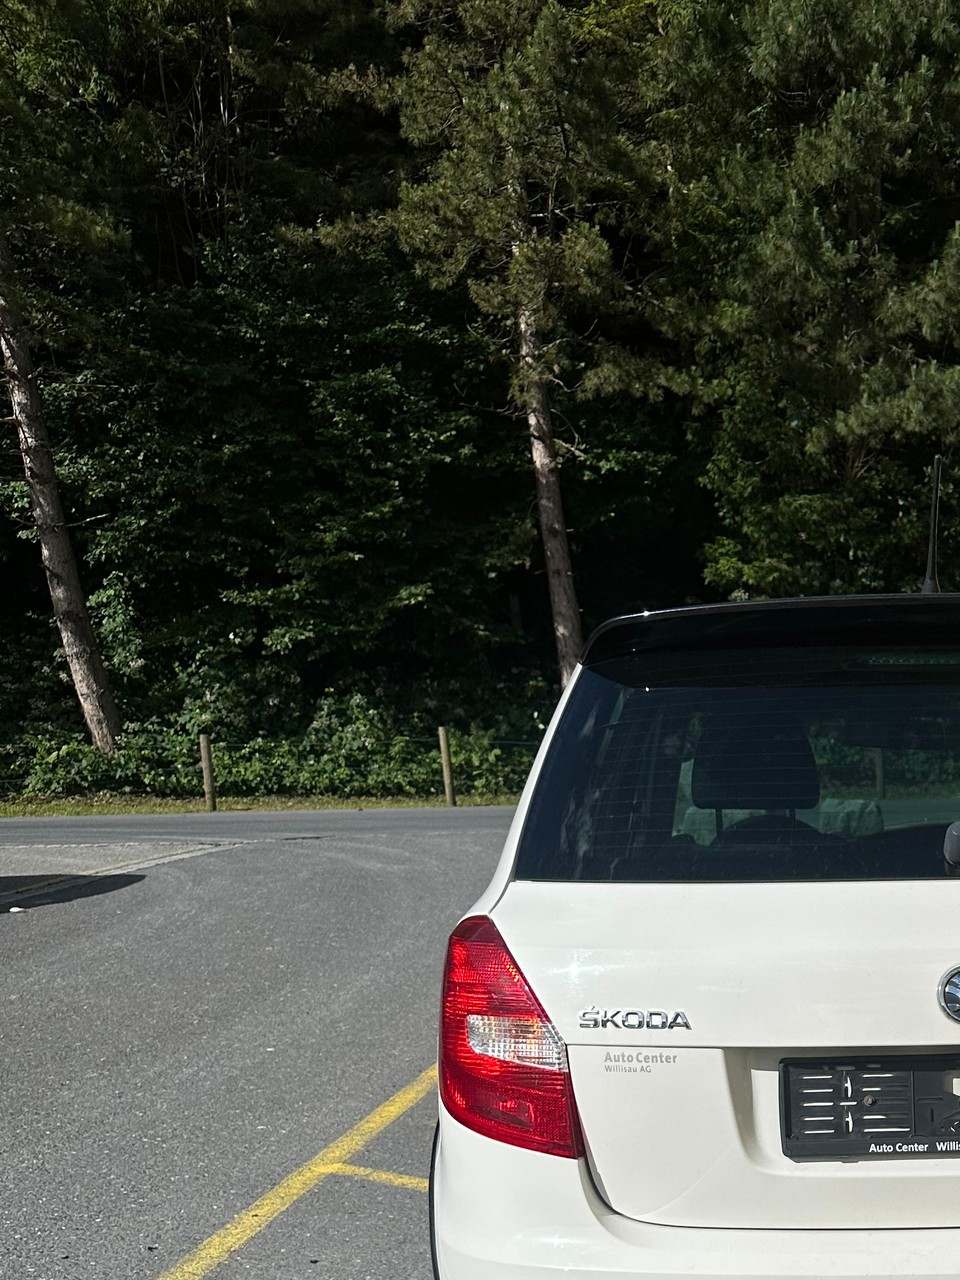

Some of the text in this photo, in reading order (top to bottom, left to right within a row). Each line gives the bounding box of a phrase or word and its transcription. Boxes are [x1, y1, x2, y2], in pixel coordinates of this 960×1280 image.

[579, 1004, 692, 1030] ŠKODA
[604, 1051, 677, 1064] Auto Center
[604, 1064, 652, 1073] Willisau AG
[869, 1143, 893, 1153] Auto
[895, 1142, 928, 1152] Center
